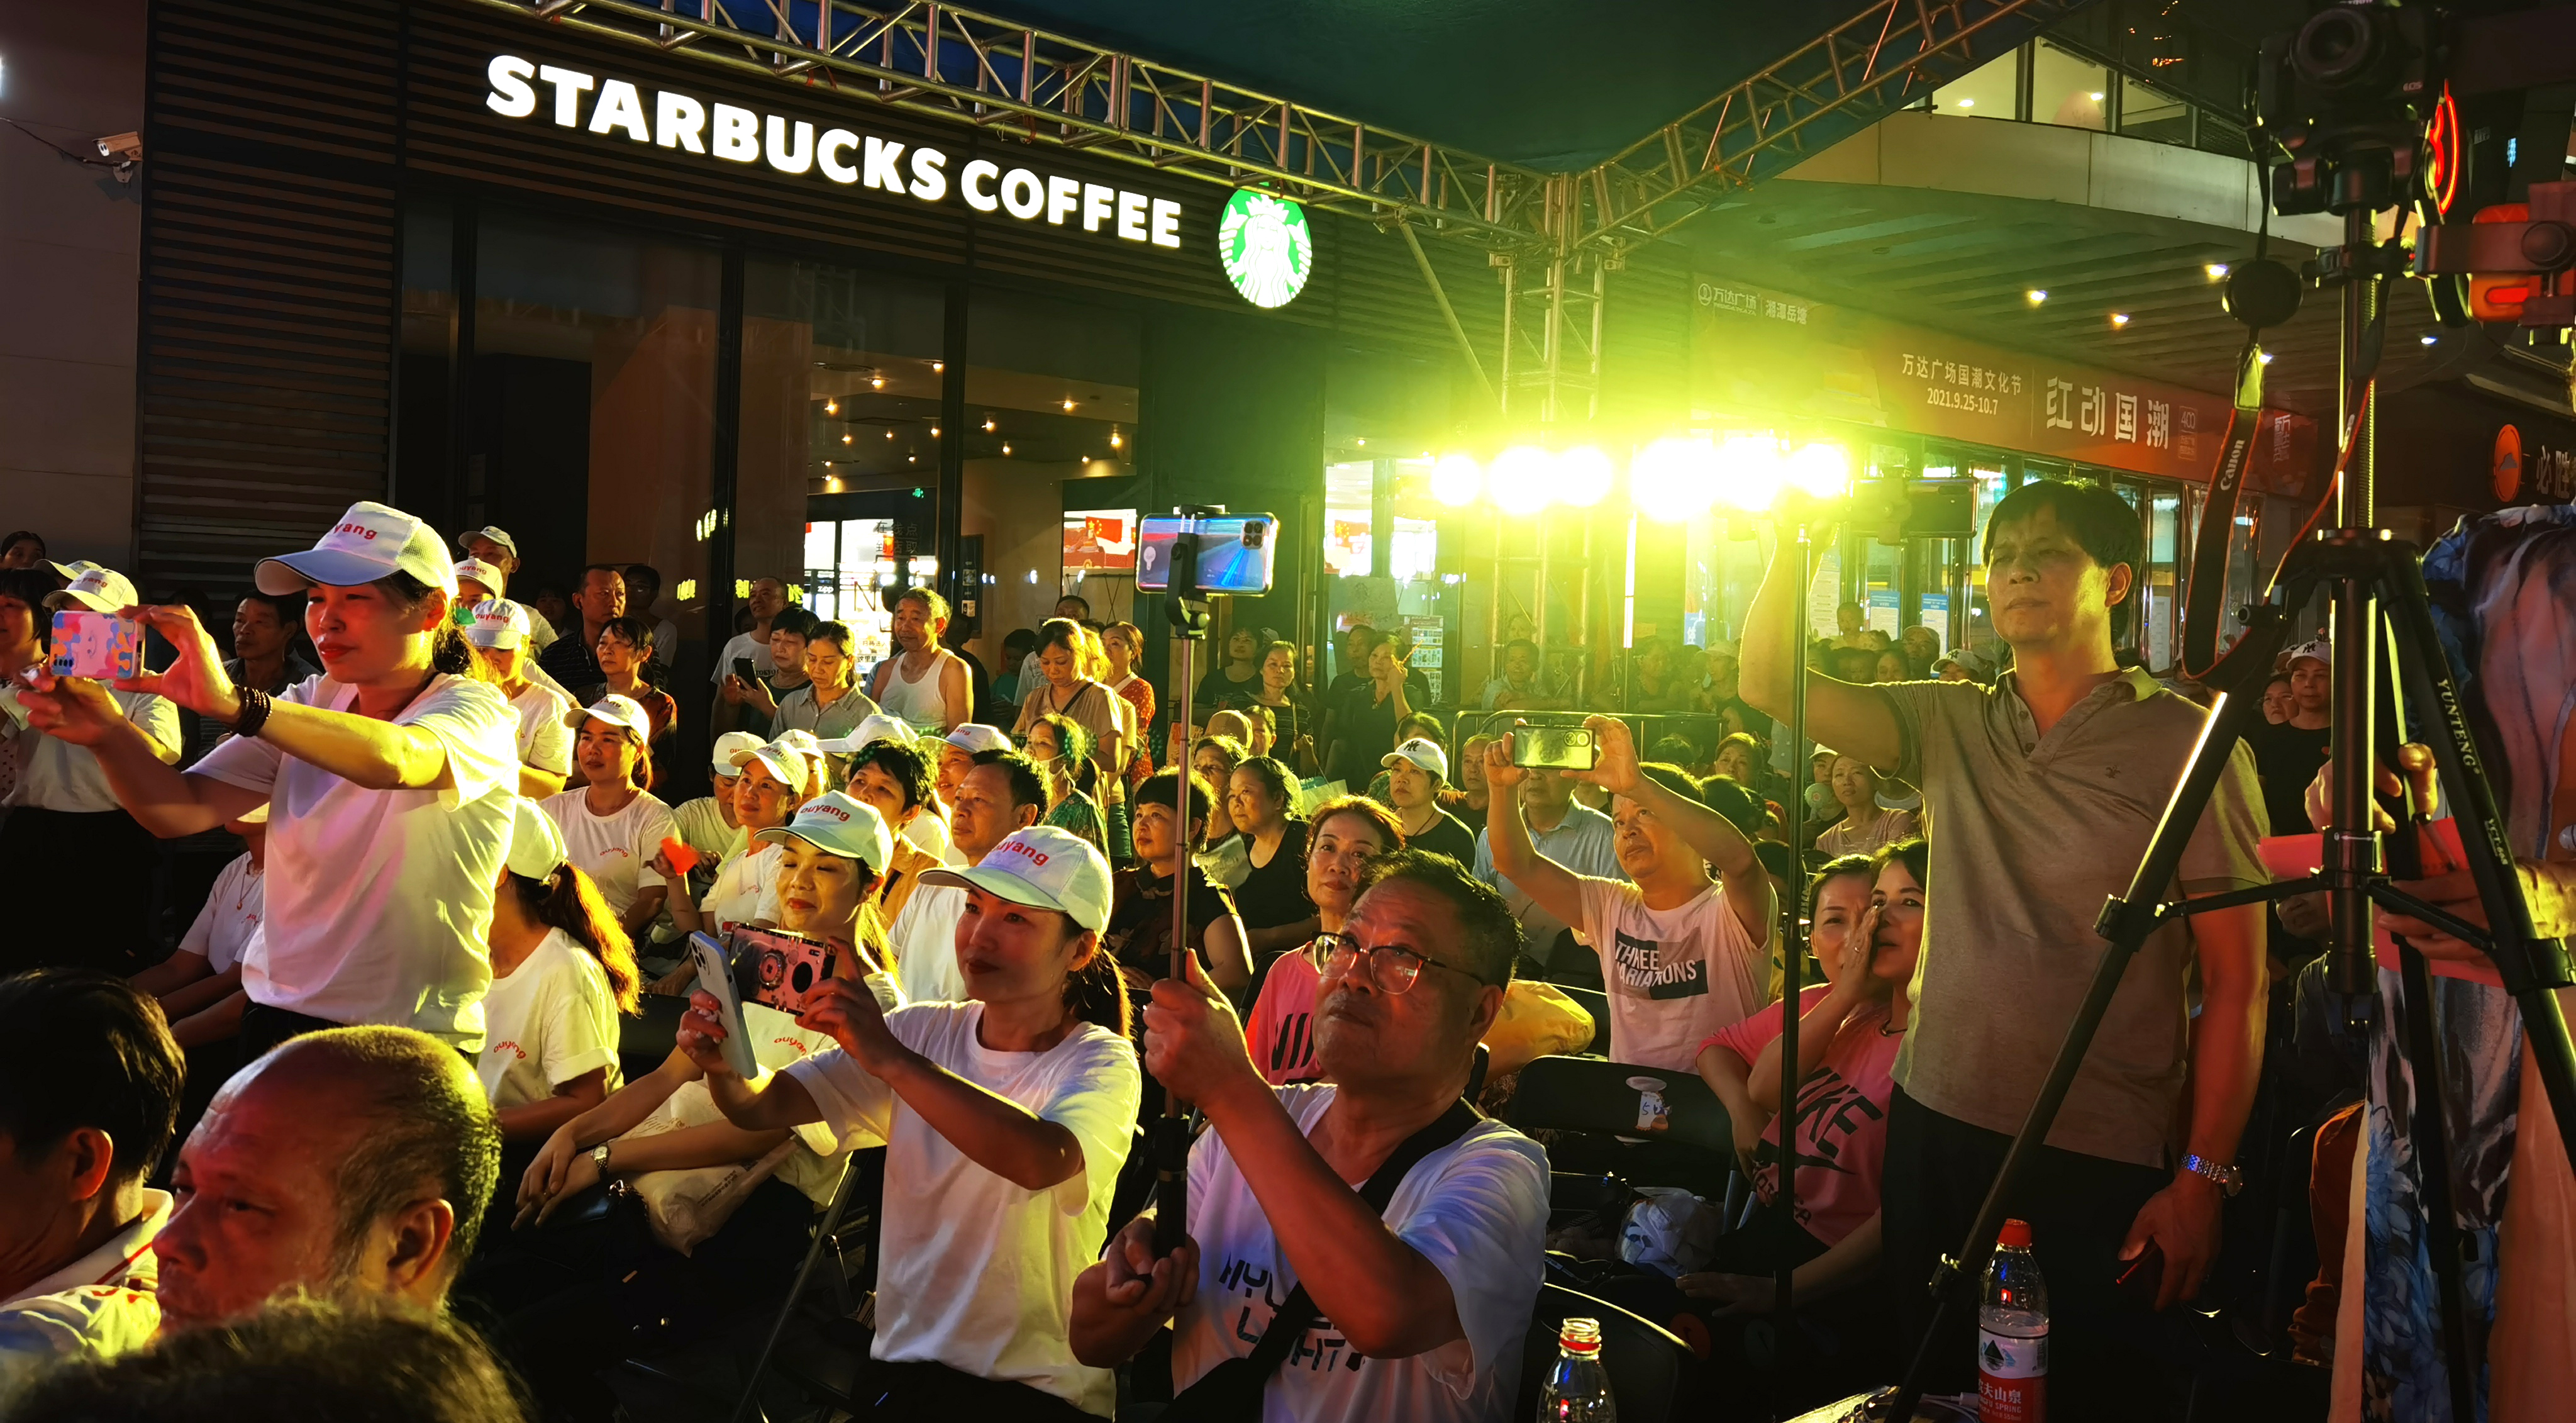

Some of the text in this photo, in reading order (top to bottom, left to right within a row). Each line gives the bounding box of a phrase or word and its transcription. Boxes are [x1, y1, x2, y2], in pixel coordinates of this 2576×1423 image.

[486, 55, 1181, 248] STARBUCKS COFFEE
[1713, 287, 1807, 325] 万达广场 湘潭岳塘
[1902, 353, 2022, 396] 万达广场国潮文化节
[2046, 376, 2170, 450] 红动国潮
[2219, 439, 2245, 491] Canon
[333, 523, 378, 540] yang
[475, 613, 509, 623] ouyang
[2437, 679, 2476, 766] YUNTENG
[800, 805, 851, 822] ouyang
[599, 847, 628, 857] ouyang
[997, 840, 1050, 866] uyang
[494, 1041, 526, 1059] ouyang
[774, 1036, 807, 1056] ouyan
[1995, 1402, 2022, 1414] SPRING
